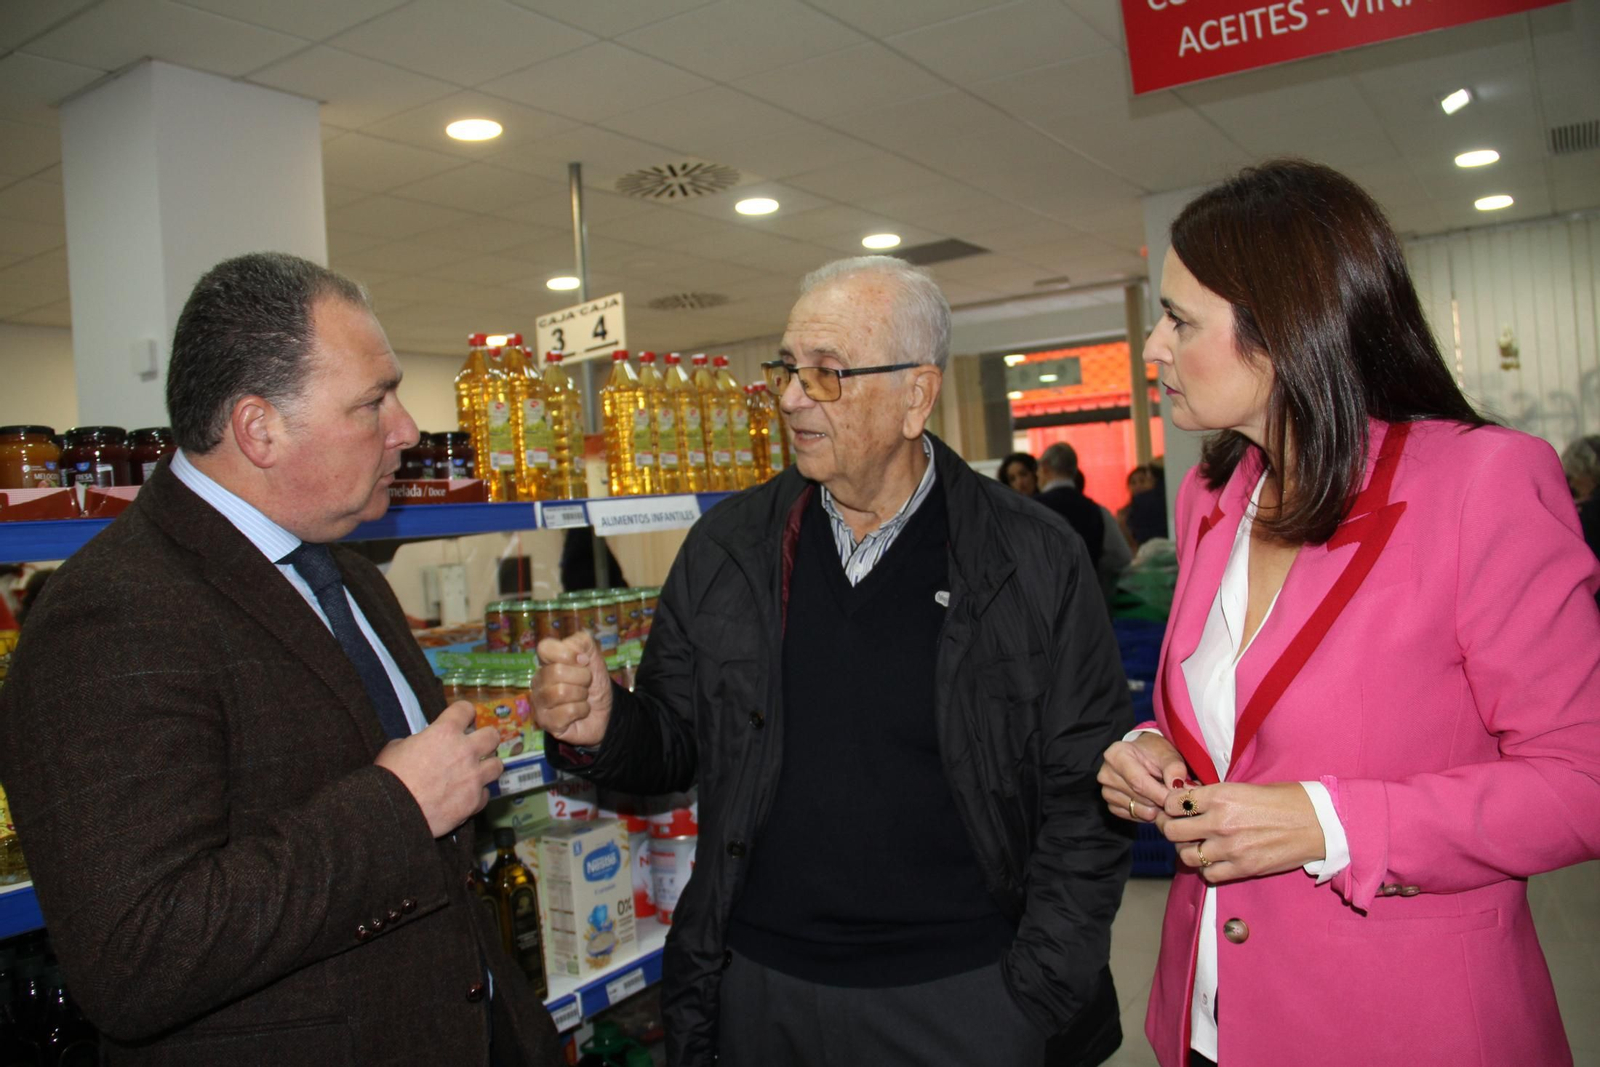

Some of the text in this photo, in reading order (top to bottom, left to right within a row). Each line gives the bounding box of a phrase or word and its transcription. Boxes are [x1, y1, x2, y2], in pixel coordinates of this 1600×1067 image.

[1178, 0, 1308, 57] ACEITES
[539, 298, 619, 328] CAJA CAJA
[551, 314, 607, 351] 3 4
[601, 510, 695, 527] ALIMENTOS INFANTILES
[555, 801, 567, 818] 2
[617, 897, 632, 916] 0%
